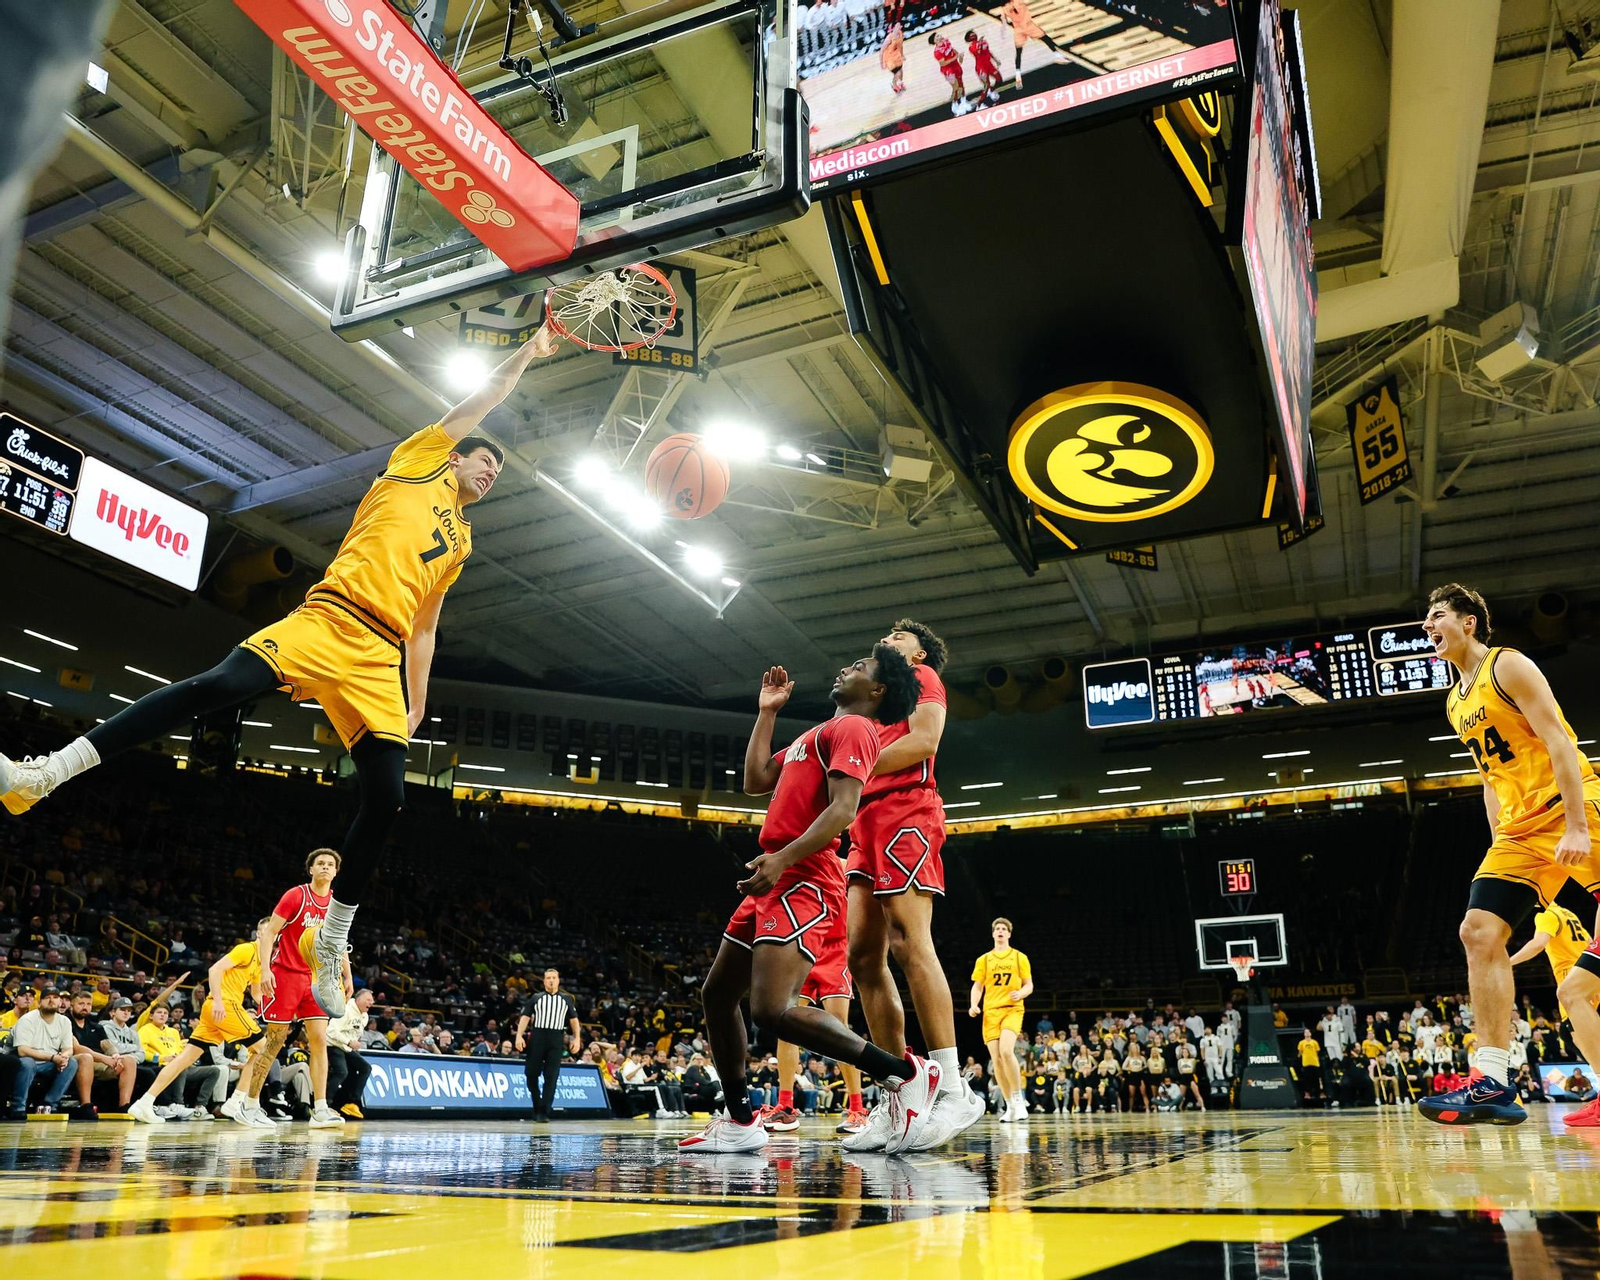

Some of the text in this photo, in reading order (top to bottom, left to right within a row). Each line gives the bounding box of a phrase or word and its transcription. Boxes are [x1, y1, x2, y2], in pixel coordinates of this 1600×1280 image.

[976, 57, 1186, 129] VOTED #1 INTERNET
[809, 138, 910, 179] Mediacom
[1362, 424, 1399, 470] 55
[26, 478, 42, 491] POSS
[1363, 464, 1409, 499] 2018-21
[14, 483, 46, 509] 11:51
[20, 504, 35, 518] 2ND
[52, 500, 67, 517] 39
[433, 506, 459, 553] Iowa
[419, 527, 449, 564] 7
[1399, 667, 1428, 681] 11:51
[1088, 682, 1148, 706] HyVee
[1337, 783, 1382, 799] IOWA
[1227, 873, 1250, 891] 30
[993, 973, 1012, 986] 27
[1287, 984, 1356, 998] HAWKEYES
[394, 1066, 509, 1099] HONKAMP
[561, 1075, 597, 1087] BUSINESS
[513, 1087, 525, 1099] OF
